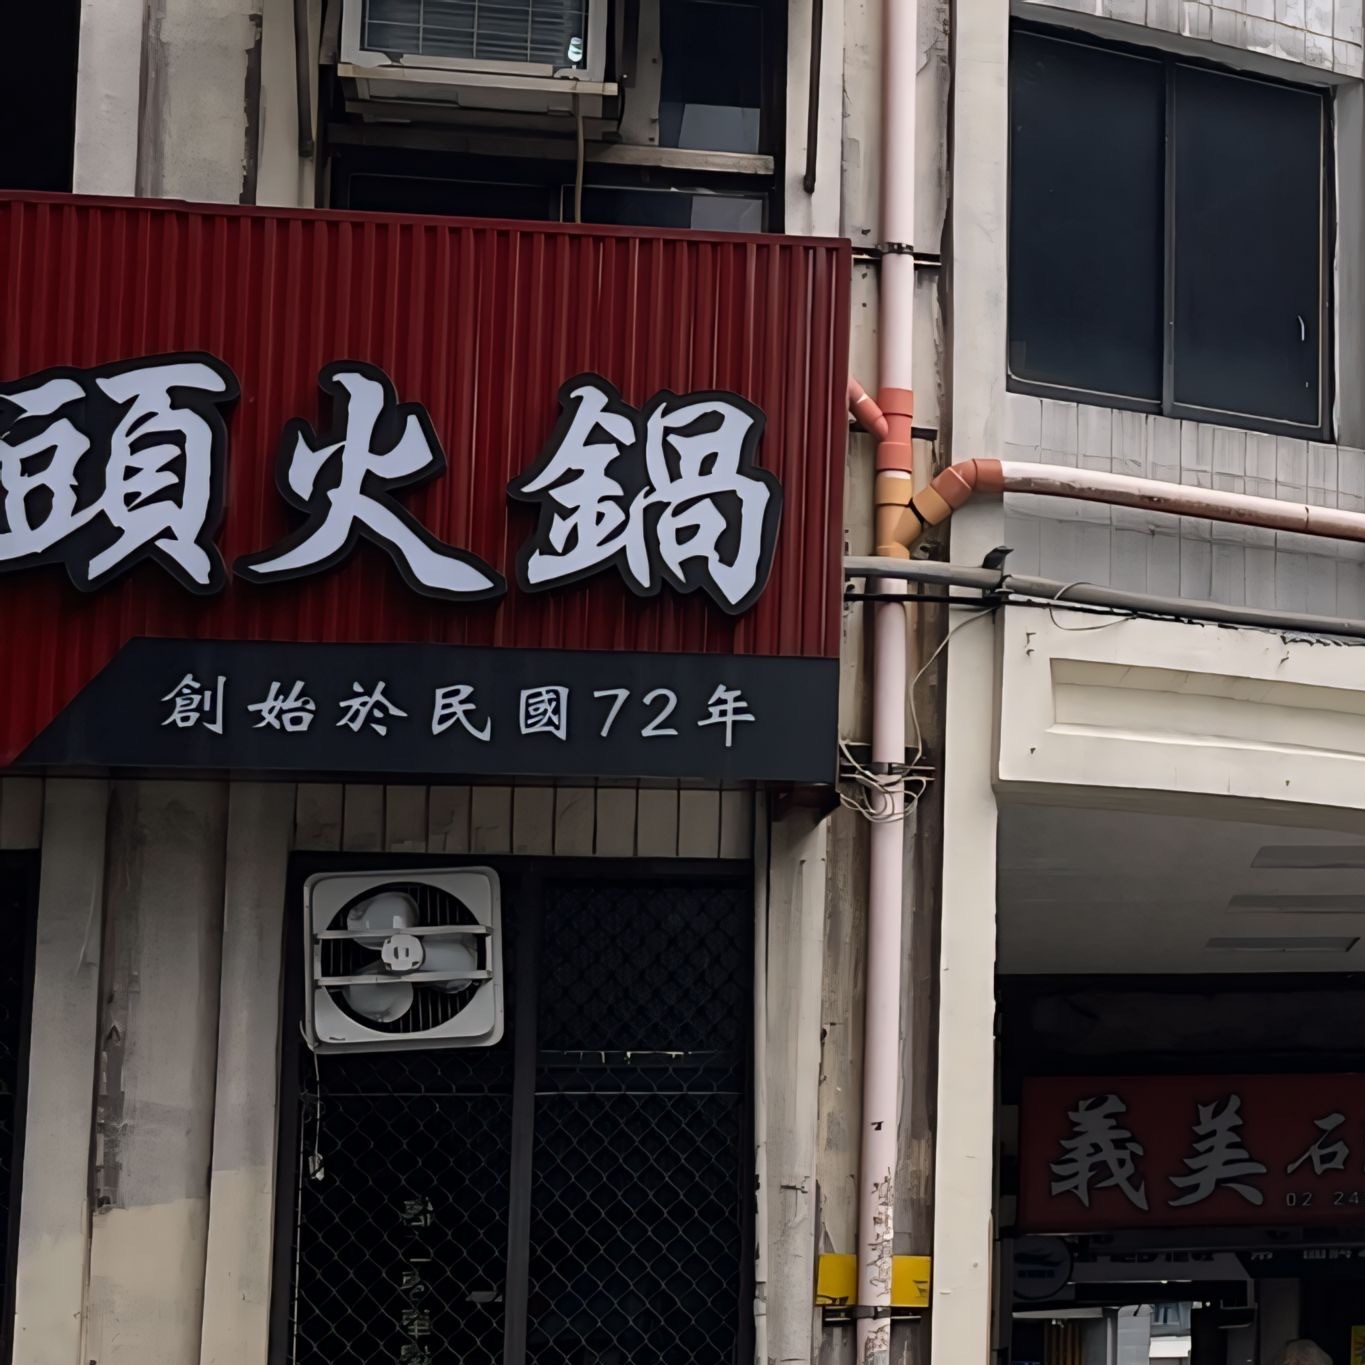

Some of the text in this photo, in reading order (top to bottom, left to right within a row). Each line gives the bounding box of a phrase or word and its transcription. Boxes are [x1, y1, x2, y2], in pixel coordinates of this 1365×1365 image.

[0, 362, 772, 606] 頭火鍋
[161, 671, 757, 749] 創始於民國72年
